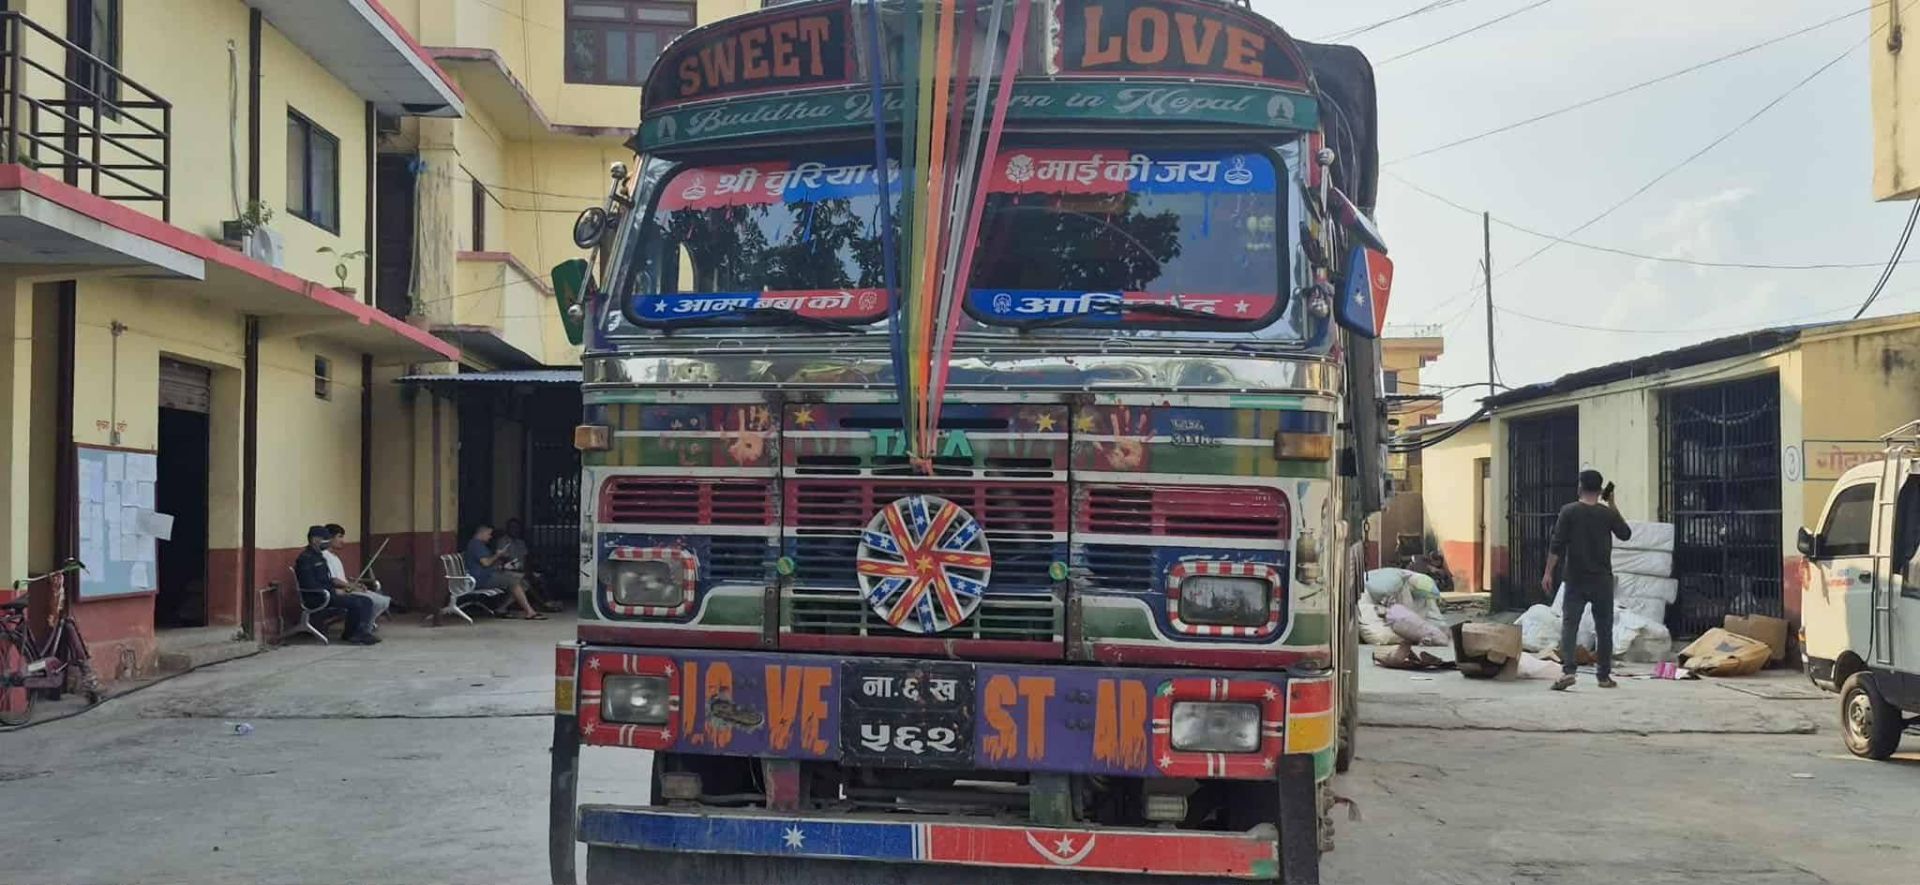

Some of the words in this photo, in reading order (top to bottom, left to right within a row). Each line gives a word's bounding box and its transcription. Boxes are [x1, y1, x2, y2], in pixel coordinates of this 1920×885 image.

[679, 16, 830, 96] SWEET
[1081, 6, 1265, 77] LOVE
[685, 101, 833, 135] Buddha
[1066, 90, 1105, 108] in
[1113, 88, 1250, 115] Nepal
[714, 167, 761, 196] श्री
[764, 161, 873, 196] चुरिया
[1036, 158, 1102, 185] माई
[1104, 154, 1151, 183] की
[1154, 159, 1222, 184] जय
[860, 724, 957, 753] ५६२
